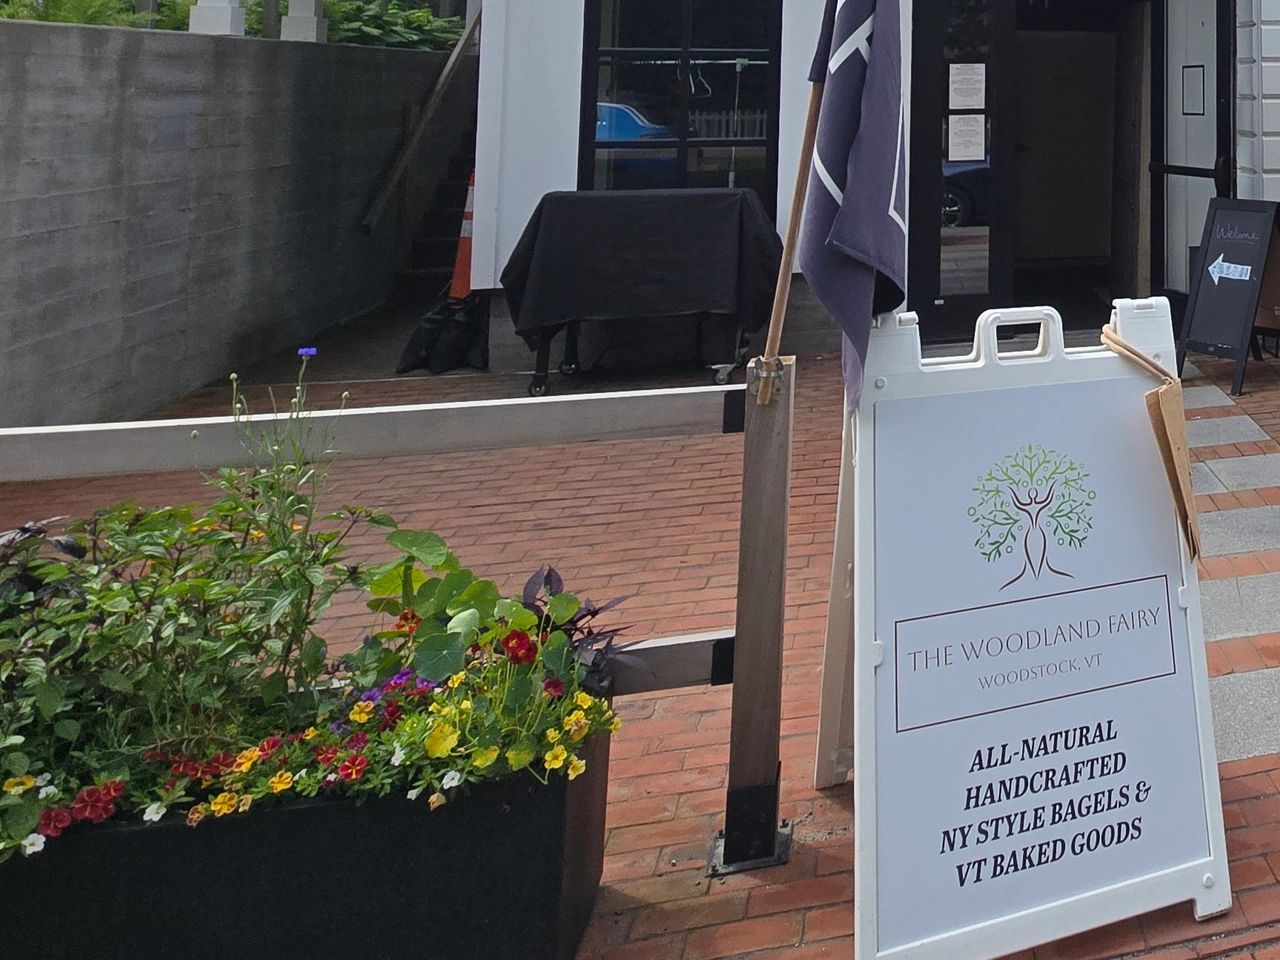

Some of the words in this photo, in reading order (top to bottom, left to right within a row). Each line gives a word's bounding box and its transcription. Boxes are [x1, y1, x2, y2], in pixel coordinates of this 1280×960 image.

[907, 645, 954, 673] THE
[961, 618, 1101, 662] WOODLAND
[1107, 606, 1161, 635] FAIRY
[977, 657, 1082, 690] WOODSTOCK,
[1084, 653, 1103, 668] VT
[968, 719, 1118, 774] ALL-NATURAL
[963, 751, 1127, 811] HANDCRAFTED
[940, 824, 974, 855] NY
[976, 806, 1046, 846] STYLE
[1049, 785, 1130, 826] BAGELS
[1134, 780, 1152, 803] &
[956, 858, 987, 888] VT
[990, 838, 1066, 879] BAKED
[1070, 816, 1143, 856] GOODS
